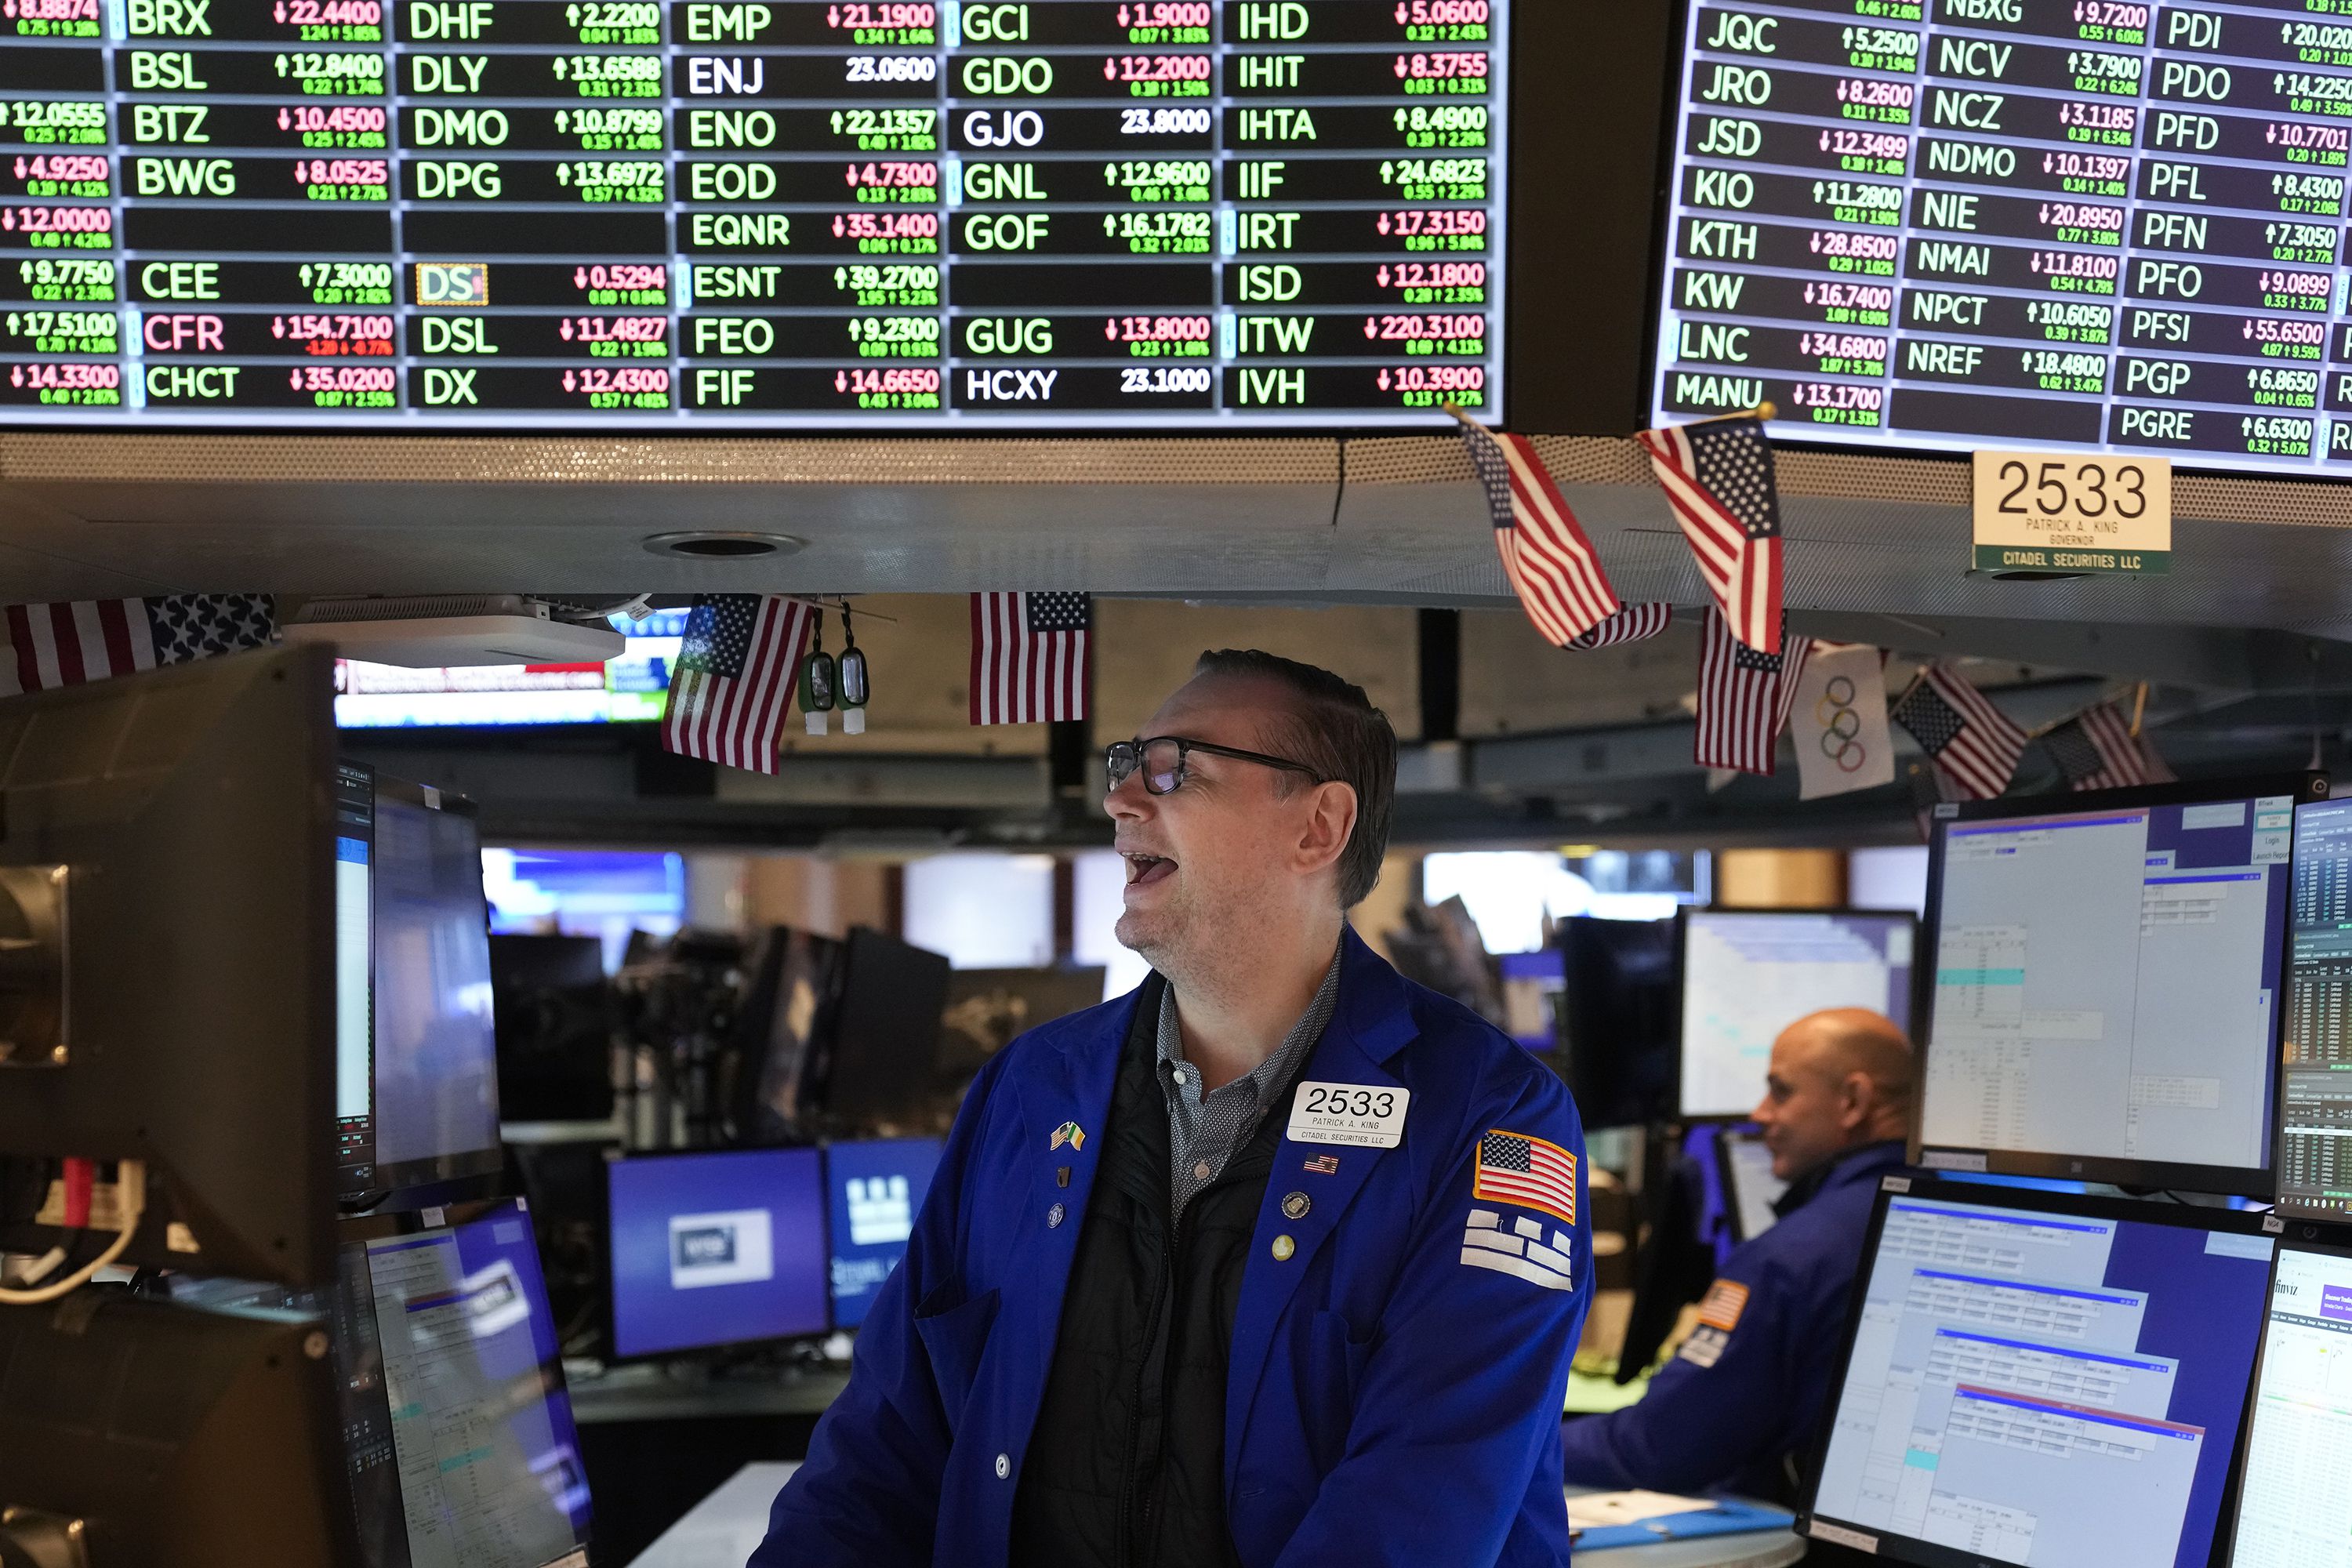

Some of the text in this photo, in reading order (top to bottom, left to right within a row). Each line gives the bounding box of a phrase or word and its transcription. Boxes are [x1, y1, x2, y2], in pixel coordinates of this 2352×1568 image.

[128, 0, 380, 35] BRX 22.4400
[411, 2, 660, 38] DHF 2.2200
[688, 4, 935, 41] EMP 21.1900
[963, 3, 1210, 41] GCI 1.9000
[1240, 0, 1488, 38] IHD 5.0600
[1946, 0, 2147, 28] NBXG 9.7200
[2169, 11, 2221, 49] PDI
[1708, 13, 1918, 56] JQC 5.2500
[132, 52, 383, 89] BSL 12.8400
[412, 56, 661, 93] DLY 13.6588
[689, 57, 935, 93] ENJ 23.0600
[963, 56, 1210, 93] GDO 12.2000
[1240, 53, 1487, 87] IHIT 8.3755
[1940, 38, 2141, 79] NCV 3.7900
[1703, 65, 1913, 107] JRO 8.2600
[2162, 62, 2352, 100] PDO 14.2250
[13, 102, 106, 127] 12.0555
[134, 105, 385, 142] BTZ 10.4500
[415, 109, 662, 145] DMO 10.8799
[1240, 107, 1486, 140] IHTA 8.4900
[1934, 90, 2135, 129] NCZ 3.1185
[691, 111, 935, 147] ENO 22.1357
[964, 109, 1210, 147] GJO 23.8000
[1698, 118, 1907, 159] JSD 12.3499
[2156, 113, 2348, 151] PFD 10.7701
[29, 156, 108, 180] 4.9250
[137, 158, 387, 195] BWG 8.0525
[1240, 159, 1485, 198] IIF 24.6823
[1929, 141, 2129, 180] NDMO 10.1397
[417, 162, 663, 198] DPG 13.6972
[692, 162, 937, 199] EOD 4.7300
[964, 162, 1210, 199] GNL 12.9600
[1694, 169, 1902, 209] KIO 11.2800
[2151, 163, 2343, 200] PFL 8.4300
[19, 209, 111, 231] 12.0000
[1923, 192, 2122, 230] NIE 20.8950
[693, 214, 938, 245] EQNR 35.1400
[965, 212, 1210, 250] GOF 16.1782
[1240, 211, 1485, 249] IRT 17.3150
[1690, 220, 1896, 260] KTH 28.8500
[2144, 213, 2336, 249] PFN 7.3050
[35, 261, 114, 284] 9.7750
[1918, 241, 2117, 278] NMAI 11.8100
[142, 263, 391, 299] CEE 7.3000
[420, 265, 666, 300] DS 0.5294
[695, 266, 938, 297] ESNT 39.2700
[1240, 263, 1484, 300] ISD 12.1800
[1685, 272, 1891, 310] KW 16.7400
[2139, 261, 2330, 297] PFO 9.0899
[24, 313, 117, 336] 17.5100
[1913, 292, 2111, 328] NPCT 10.6050
[2133, 310, 2324, 344] PFSI 55.6500
[144, 315, 393, 350] CFR 154.7100
[423, 318, 666, 353] DSL 11.4827
[695, 318, 939, 354] FEO 9.2300
[966, 317, 1210, 354] GUG 13.8000
[1240, 315, 1484, 352] ITW 220.3100
[1681, 323, 1886, 361] LNC 34.6800
[27, 365, 119, 389] 14.3300
[1908, 343, 2106, 377] NREF 18.4800
[2127, 360, 2318, 394] PGP 6.8650
[147, 367, 395, 397] CHCT 35.0200
[424, 368, 669, 404] DX 12.4300
[697, 369, 939, 405] FIF 14.6650
[967, 368, 1210, 400] HCXY 23.1000
[1240, 367, 1483, 404] IVH 10.3900
[1676, 374, 1881, 410] MANU 13.1700
[2122, 408, 2194, 439] PGRE
[2254, 417, 2312, 441] 6.6300
[1998, 461, 2146, 518] 2533
[2026, 517, 2118, 533] PATRICK A. KING
[2049, 534, 2095, 546] GOVERNOR
[2003, 551, 2141, 569] CITADEL SECURITIES LLC
[1305, 1088, 1395, 1118] 2533
[1301, 1131, 1327, 1140] CITADEL
[1331, 1134, 1368, 1143] SECURITIES
[1312, 1117, 1344, 1127] PATRICK
[1361, 1121, 1380, 1130] KING
